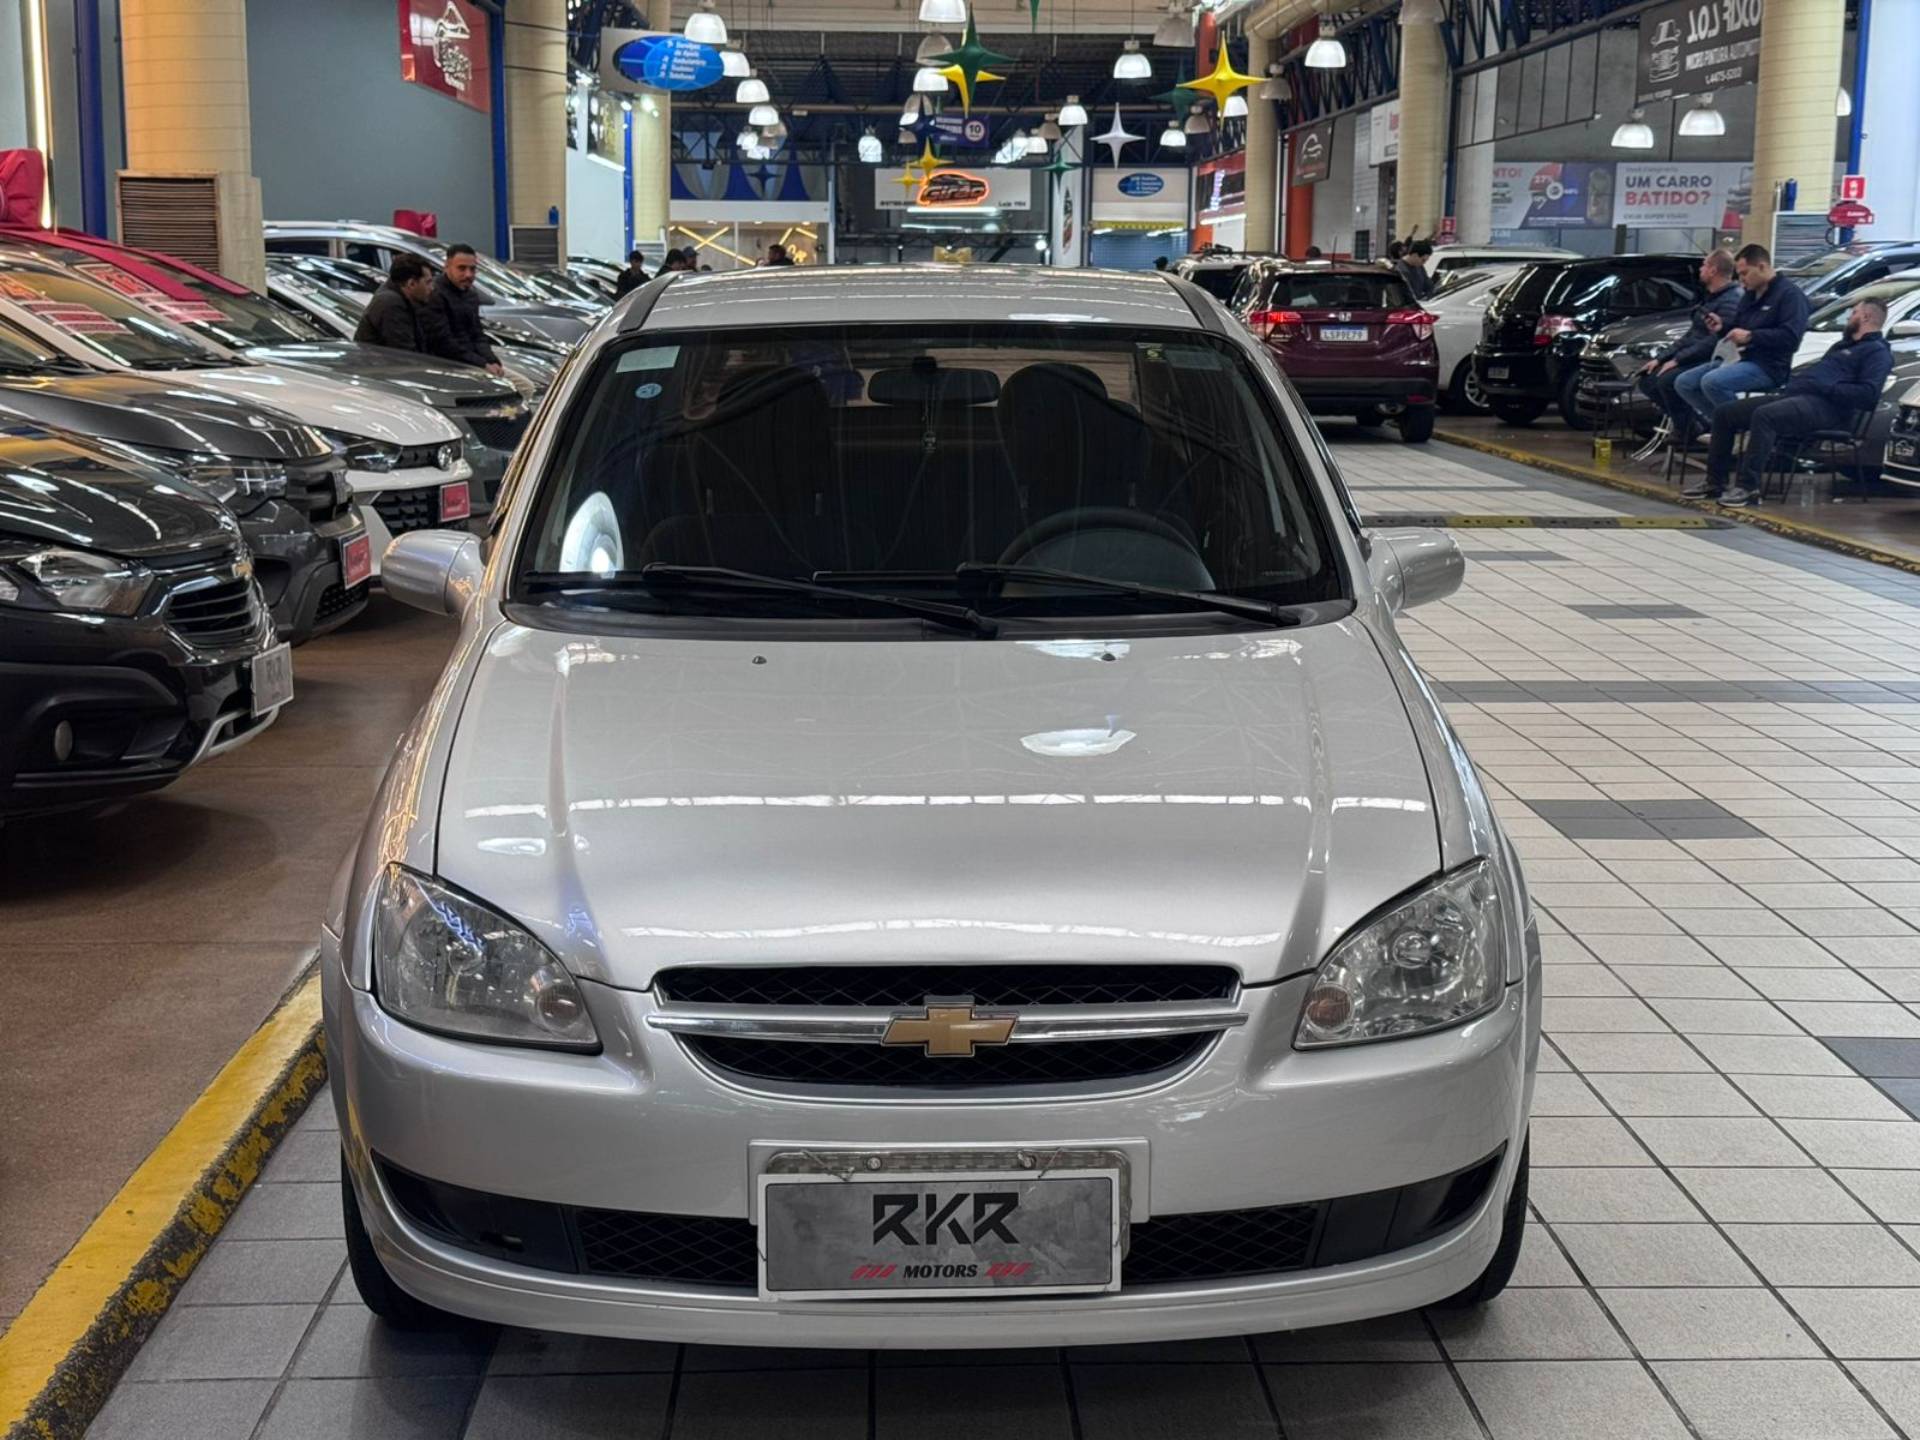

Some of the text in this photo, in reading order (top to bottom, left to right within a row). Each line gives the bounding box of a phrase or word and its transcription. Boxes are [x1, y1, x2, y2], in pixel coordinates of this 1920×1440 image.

[1625, 175, 1712, 188] UM CARRO
[1625, 190, 1711, 206] BATIDO?
[872, 1192, 1019, 1246] RKR
[903, 1263, 978, 1279] MOTORS
